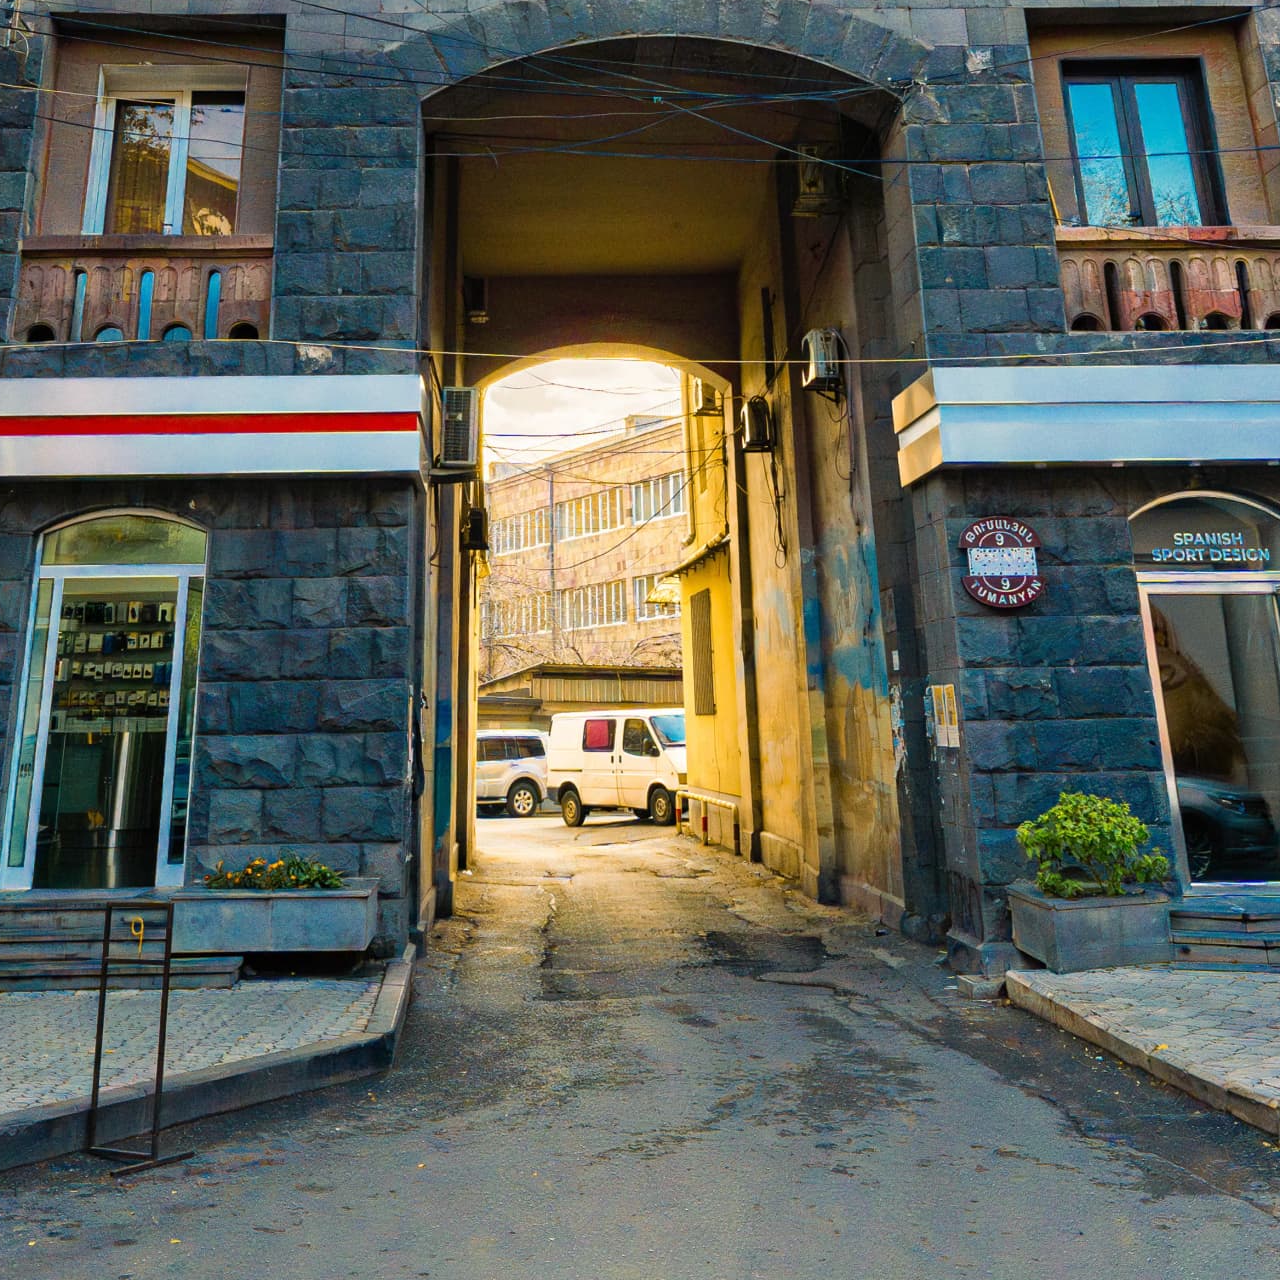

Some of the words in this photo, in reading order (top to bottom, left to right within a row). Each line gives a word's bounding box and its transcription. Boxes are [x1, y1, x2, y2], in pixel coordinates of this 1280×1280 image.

[965, 519, 1033, 543] ԹՈՒՄԱՆՅԱՆ
[995, 533, 1005, 546] 9
[1173, 532, 1244, 545] SPANISH
[1151, 548, 1205, 561] SPORT
[1209, 548, 1270, 561] DESIGN
[1000, 578, 1010, 589] 9
[970, 579, 1042, 605] TUMANYAN
[131, 916, 144, 959] 9
